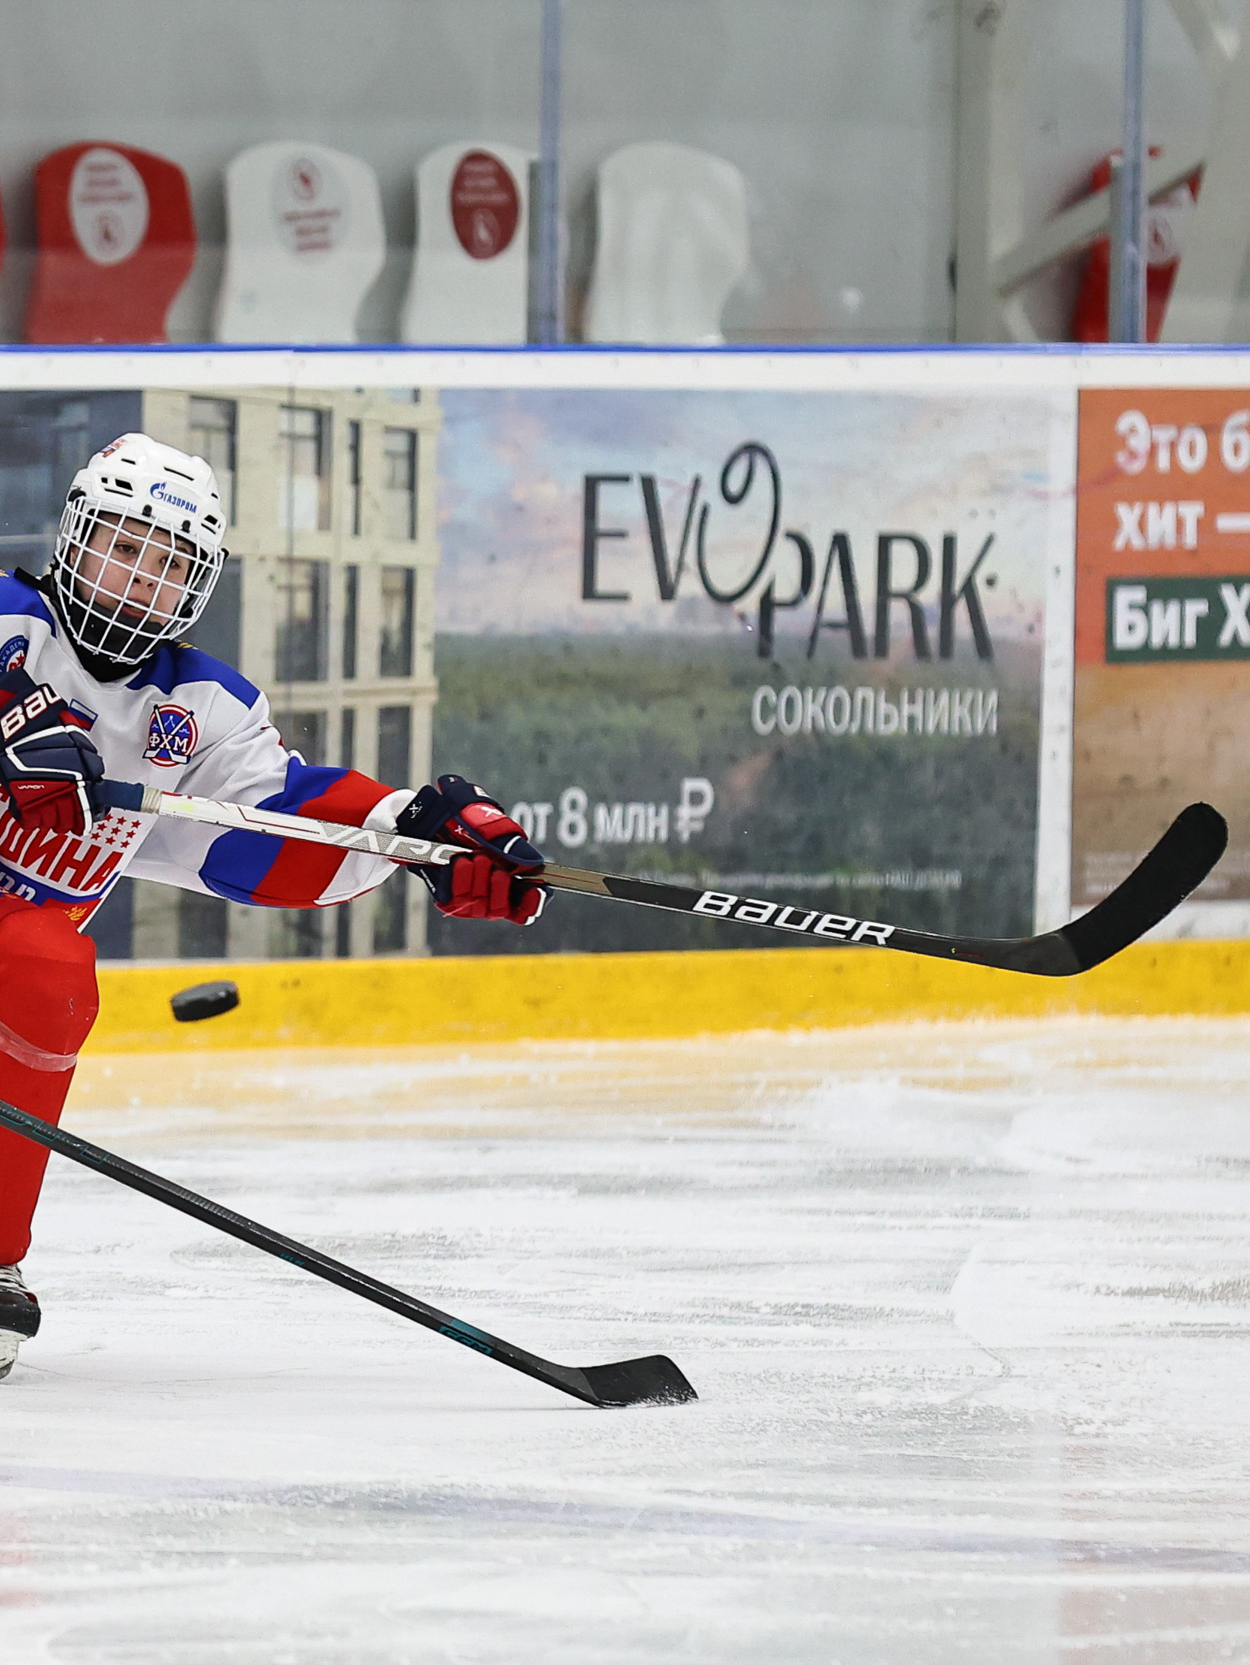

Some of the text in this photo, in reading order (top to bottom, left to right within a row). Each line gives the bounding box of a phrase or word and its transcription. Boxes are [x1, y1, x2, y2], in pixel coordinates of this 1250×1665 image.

[1114, 409, 1208, 475] Это
[1113, 584, 1210, 650] Биг
[752, 684, 999, 737] СОКОЛЬНИКИ
[148, 732, 189, 753] ФХМ
[557, 786, 589, 848] 8
